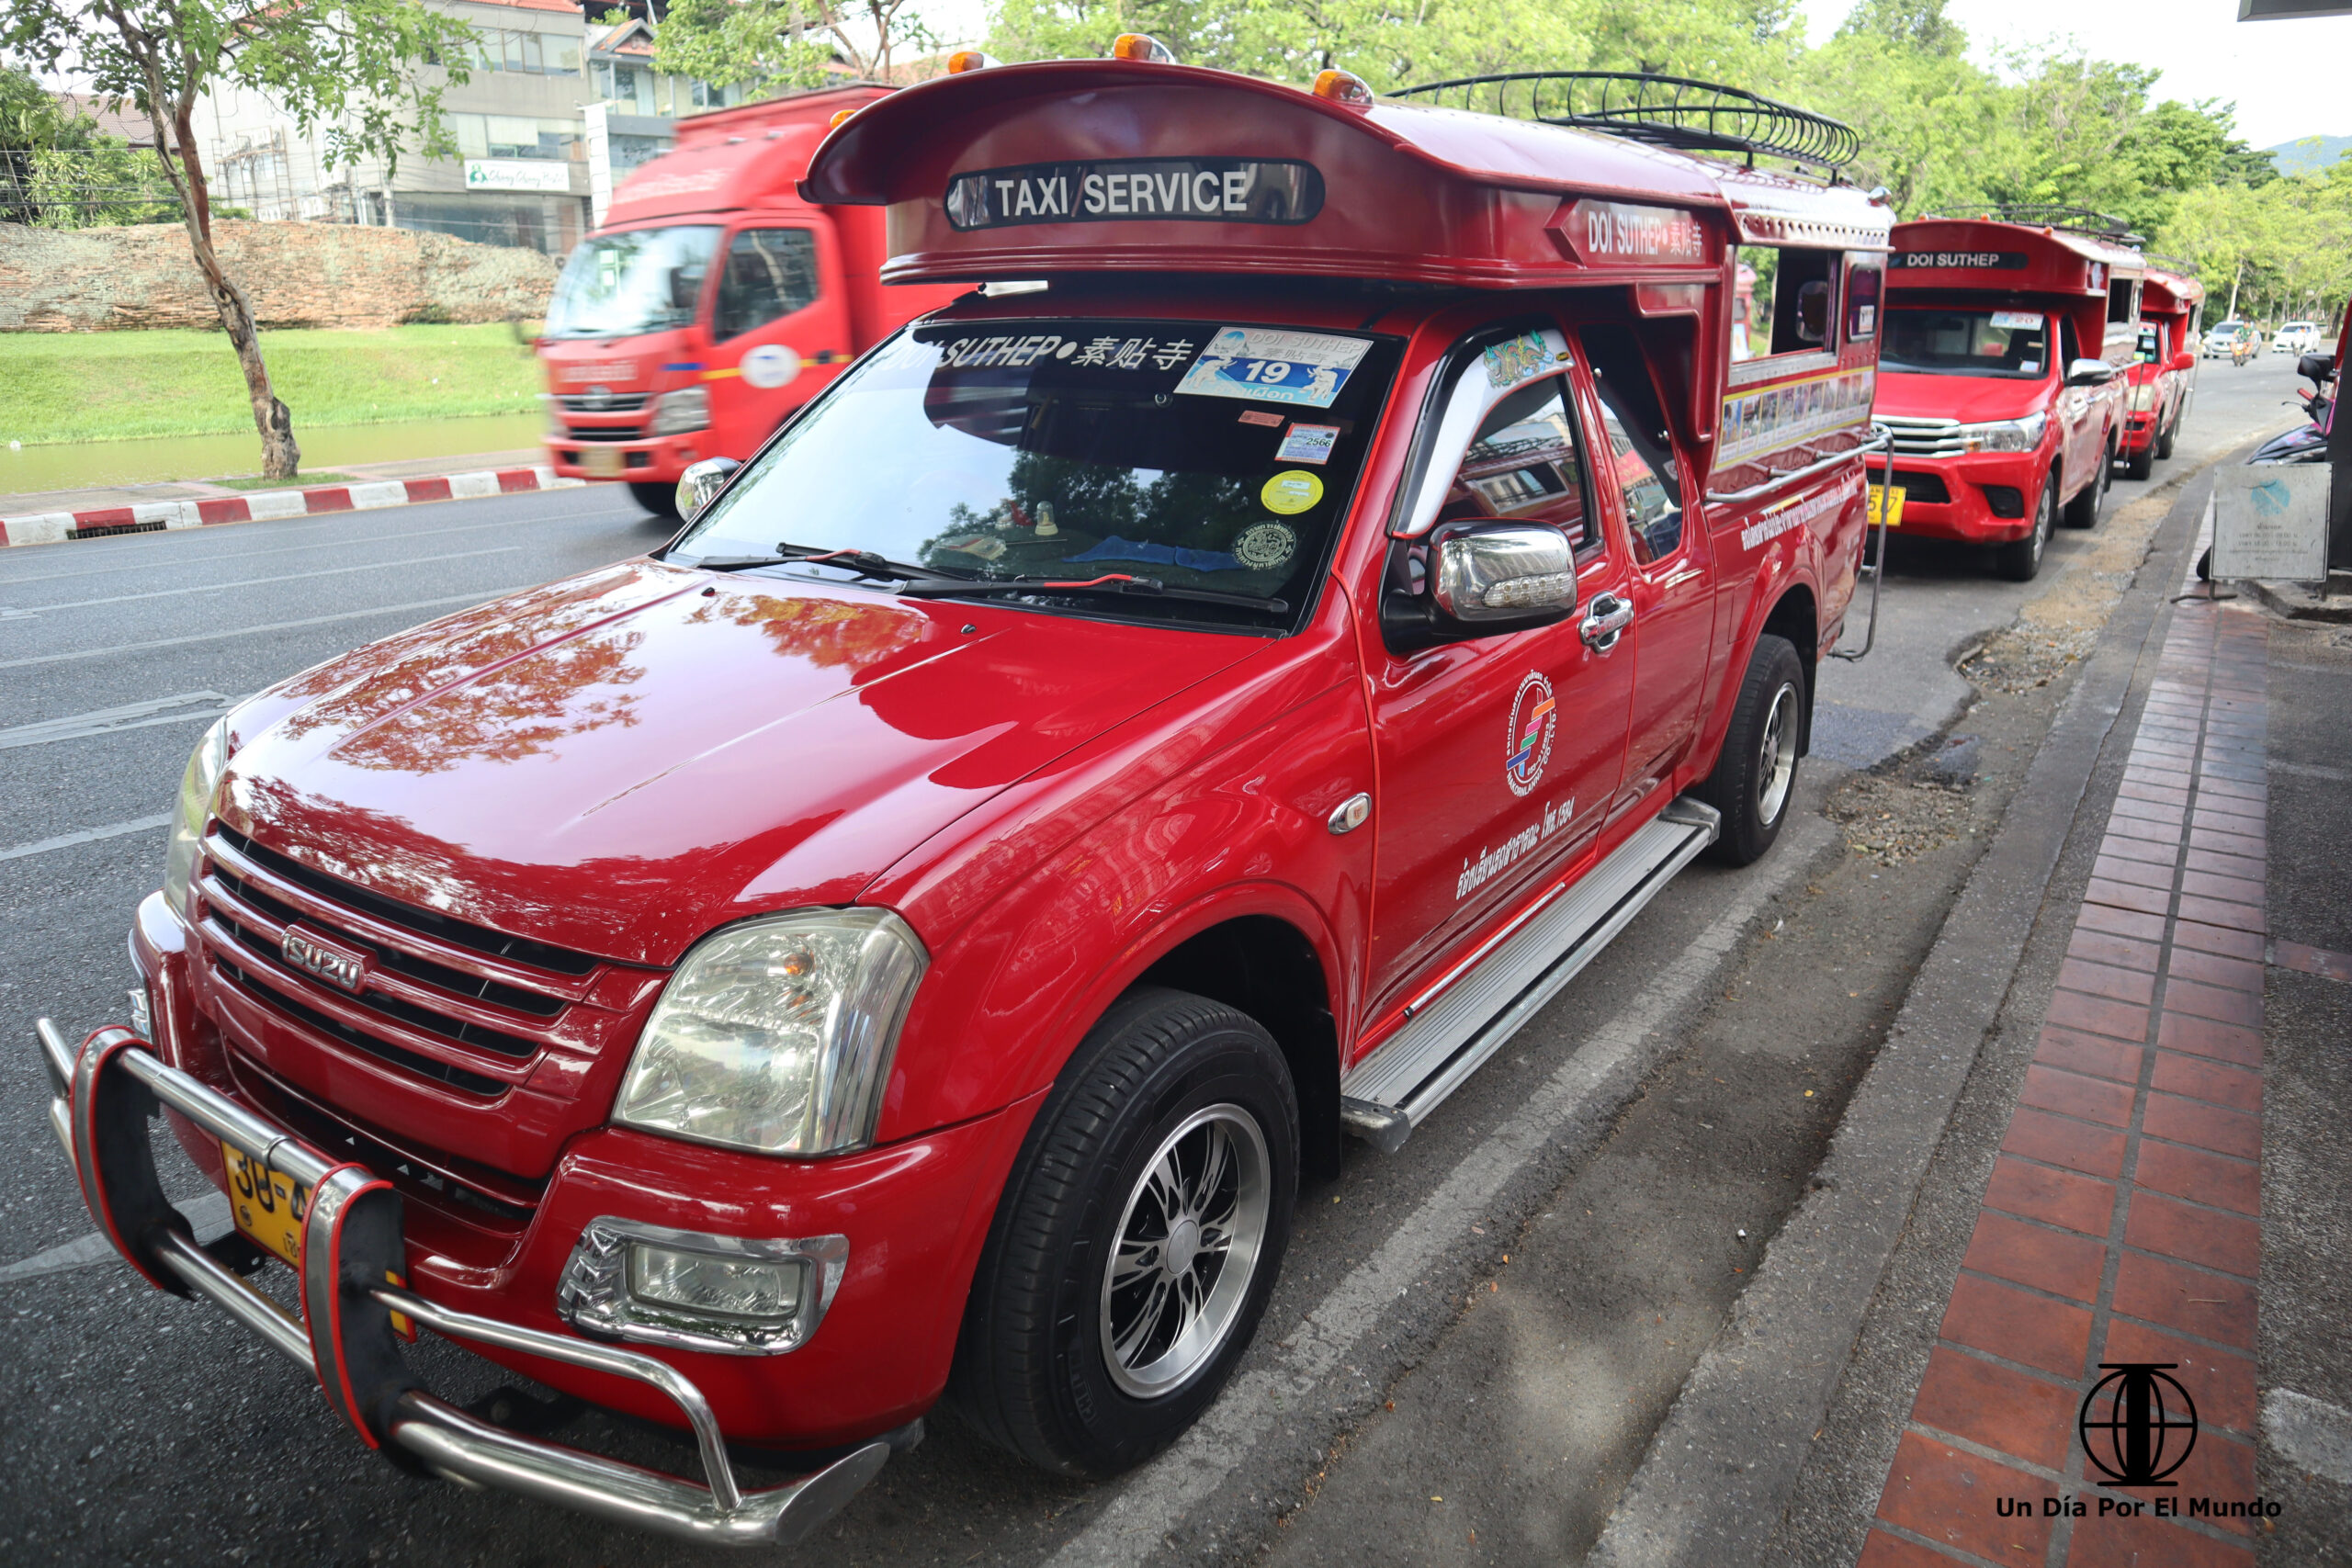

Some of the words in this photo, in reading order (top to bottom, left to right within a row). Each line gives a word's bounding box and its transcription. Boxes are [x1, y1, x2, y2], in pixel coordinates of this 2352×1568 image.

[995, 175, 1069, 216] TAXI
[1084, 171, 1248, 213] SERVICE
[1589, 211, 1612, 254] DOI
[1617, 213, 1662, 255] SUTHEP
[1906, 253, 1934, 267] DOI
[1937, 253, 1999, 267] SUTHEP
[939, 335, 1062, 368] SUTHEP
[1250, 332, 1283, 345] DOI
[1291, 335, 1364, 355] SUTHEP
[1245, 360, 1292, 384] 19
[1306, 437, 1332, 447] 2566
[1506, 767, 1544, 797] NAKORNLANNA
[281, 932, 360, 989] ISUZU
